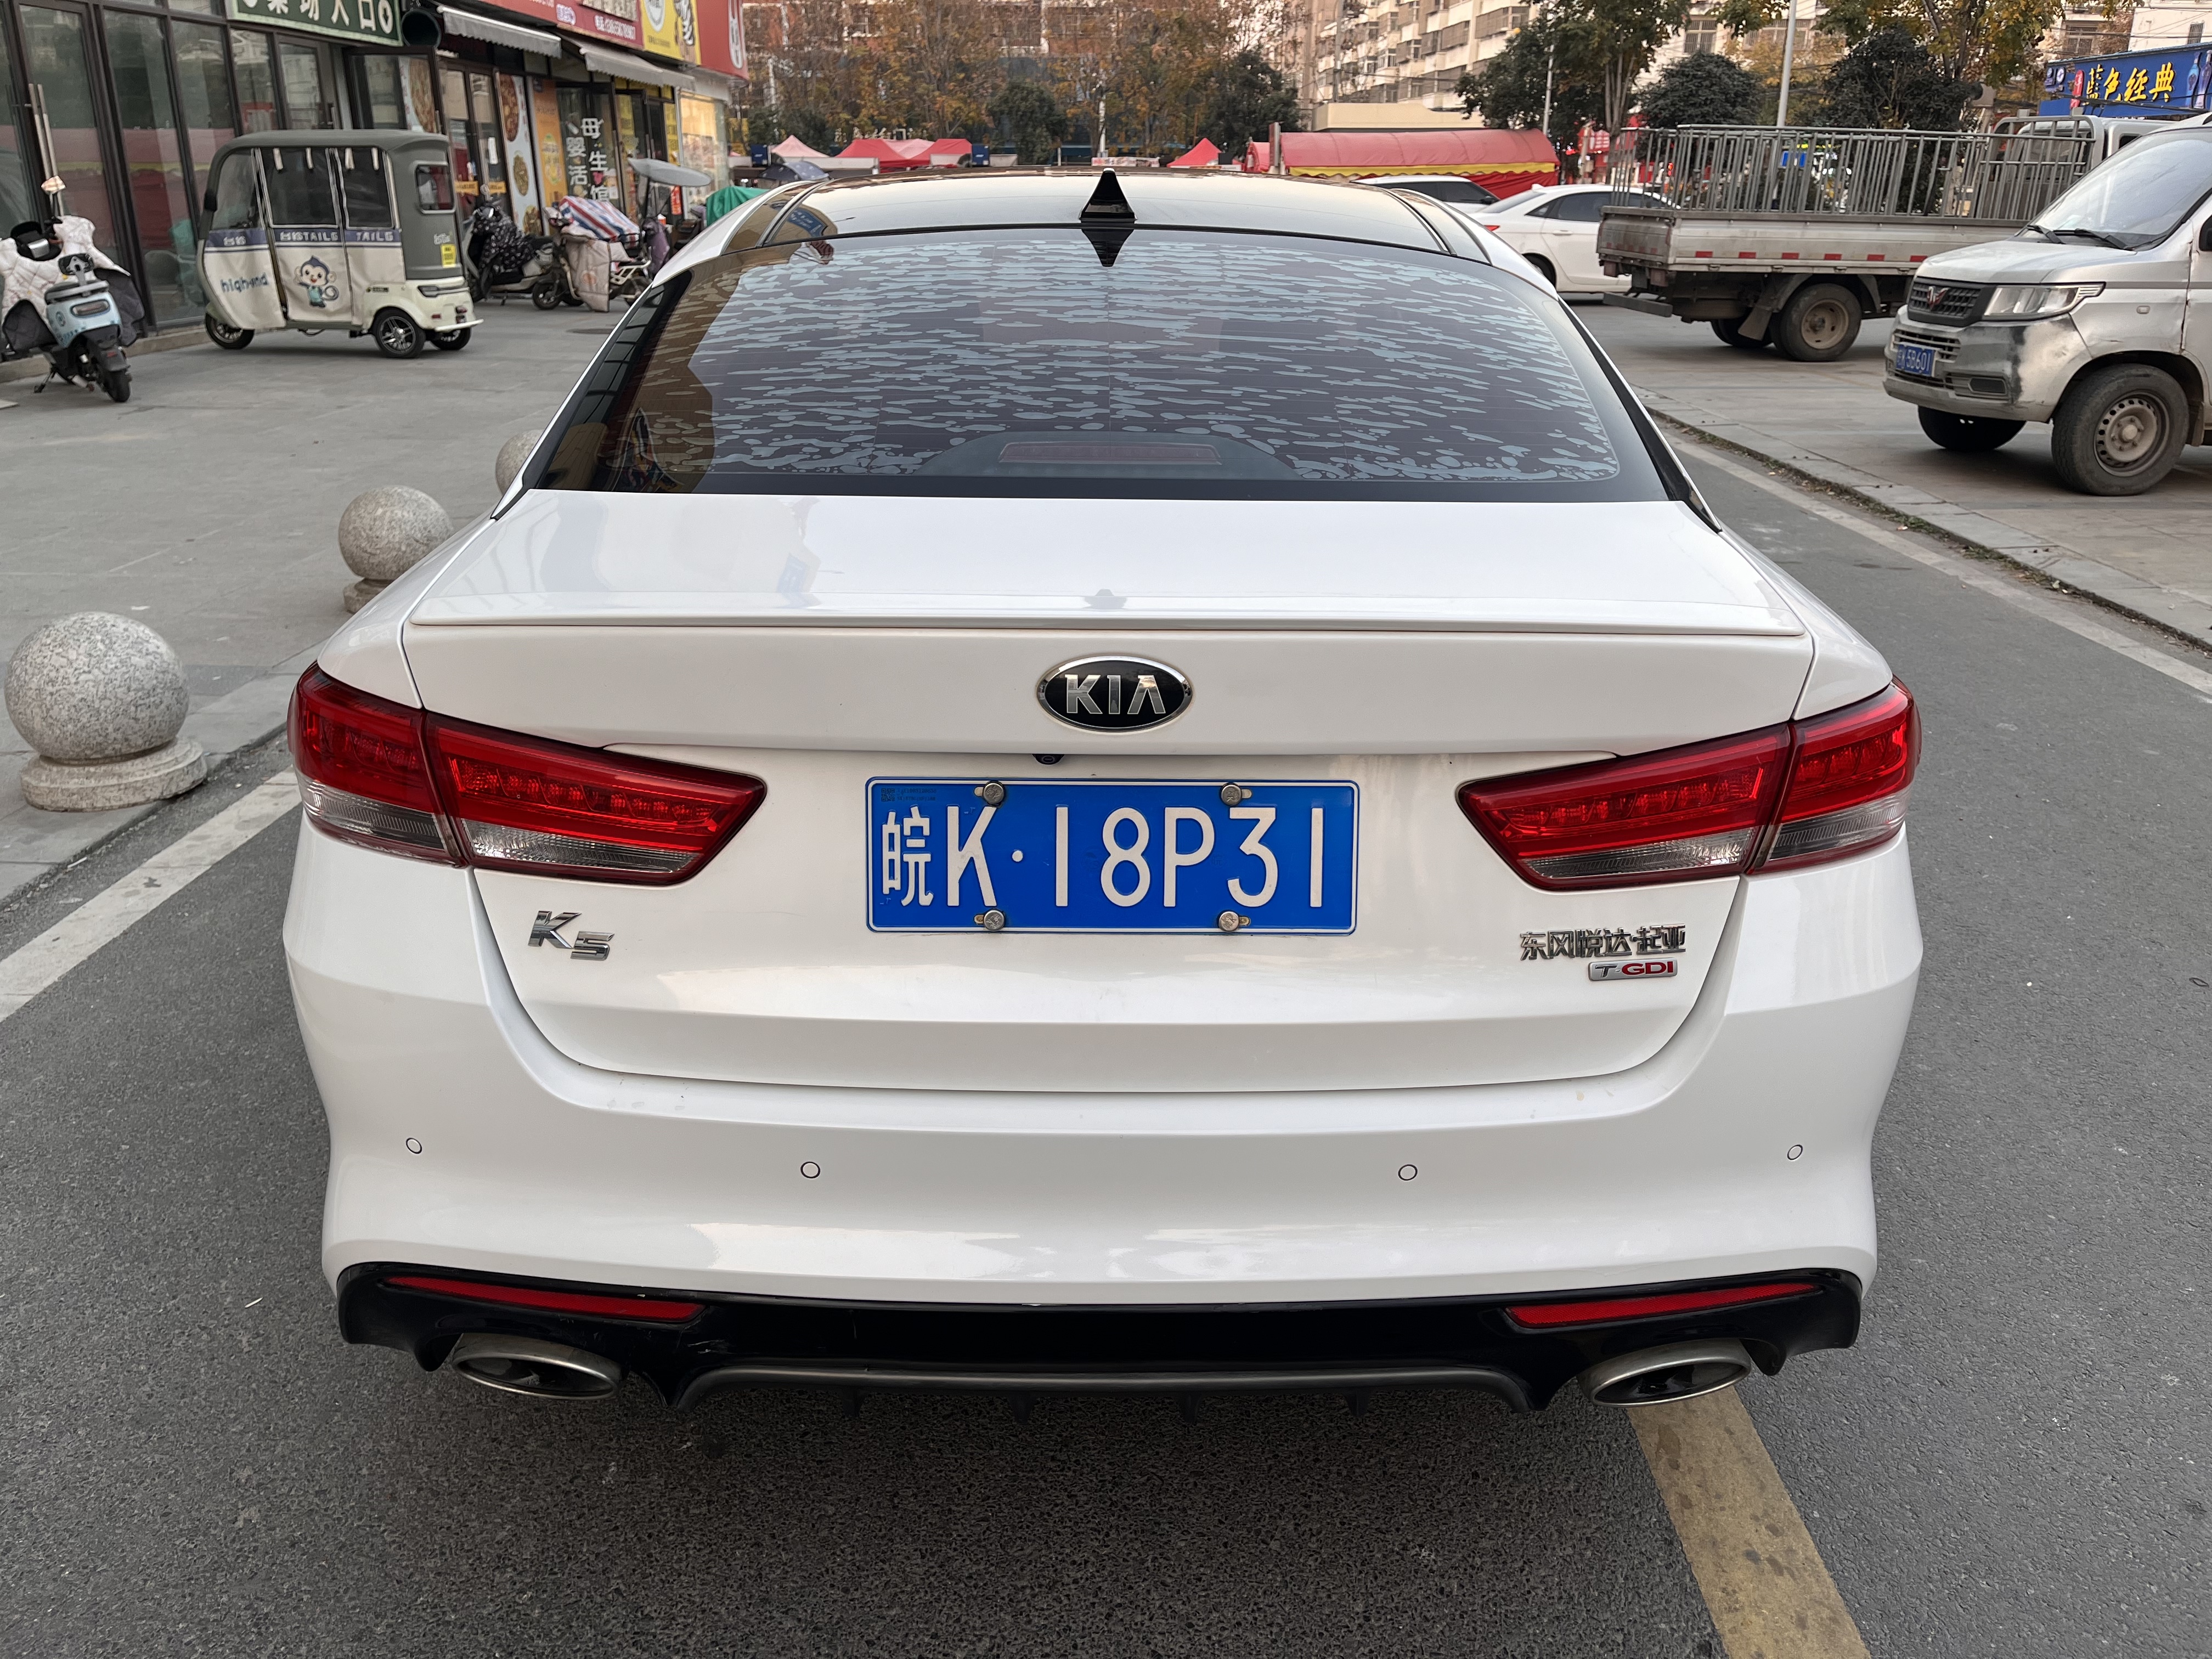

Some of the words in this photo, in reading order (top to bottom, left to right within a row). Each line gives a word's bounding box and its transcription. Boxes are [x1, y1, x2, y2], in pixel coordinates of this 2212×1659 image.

[356, 232, 394, 241] TAILG
[1064, 674, 1166, 715] KIA
[528, 910, 615, 961] K5
